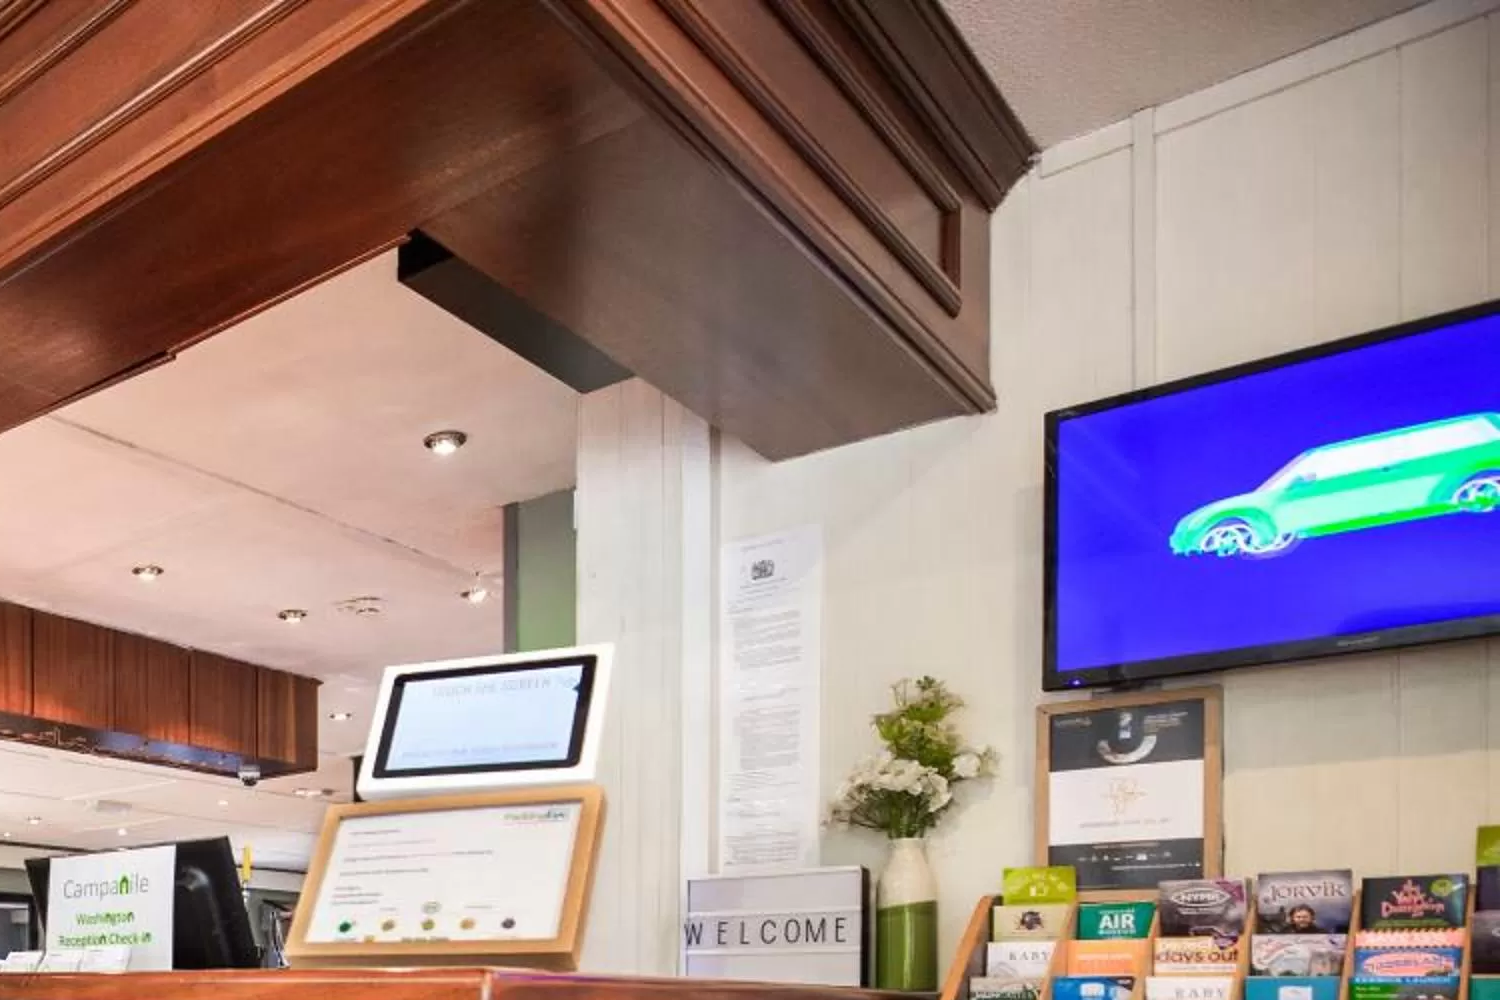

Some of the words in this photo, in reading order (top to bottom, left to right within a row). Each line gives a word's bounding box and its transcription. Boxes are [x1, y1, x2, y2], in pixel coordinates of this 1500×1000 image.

[63, 872, 149, 901] Campanile
[76, 911, 135, 928] Washington
[1099, 914, 1135, 929] AIR
[684, 917, 848, 945] WELCOME
[58, 935, 107, 947] Reception
